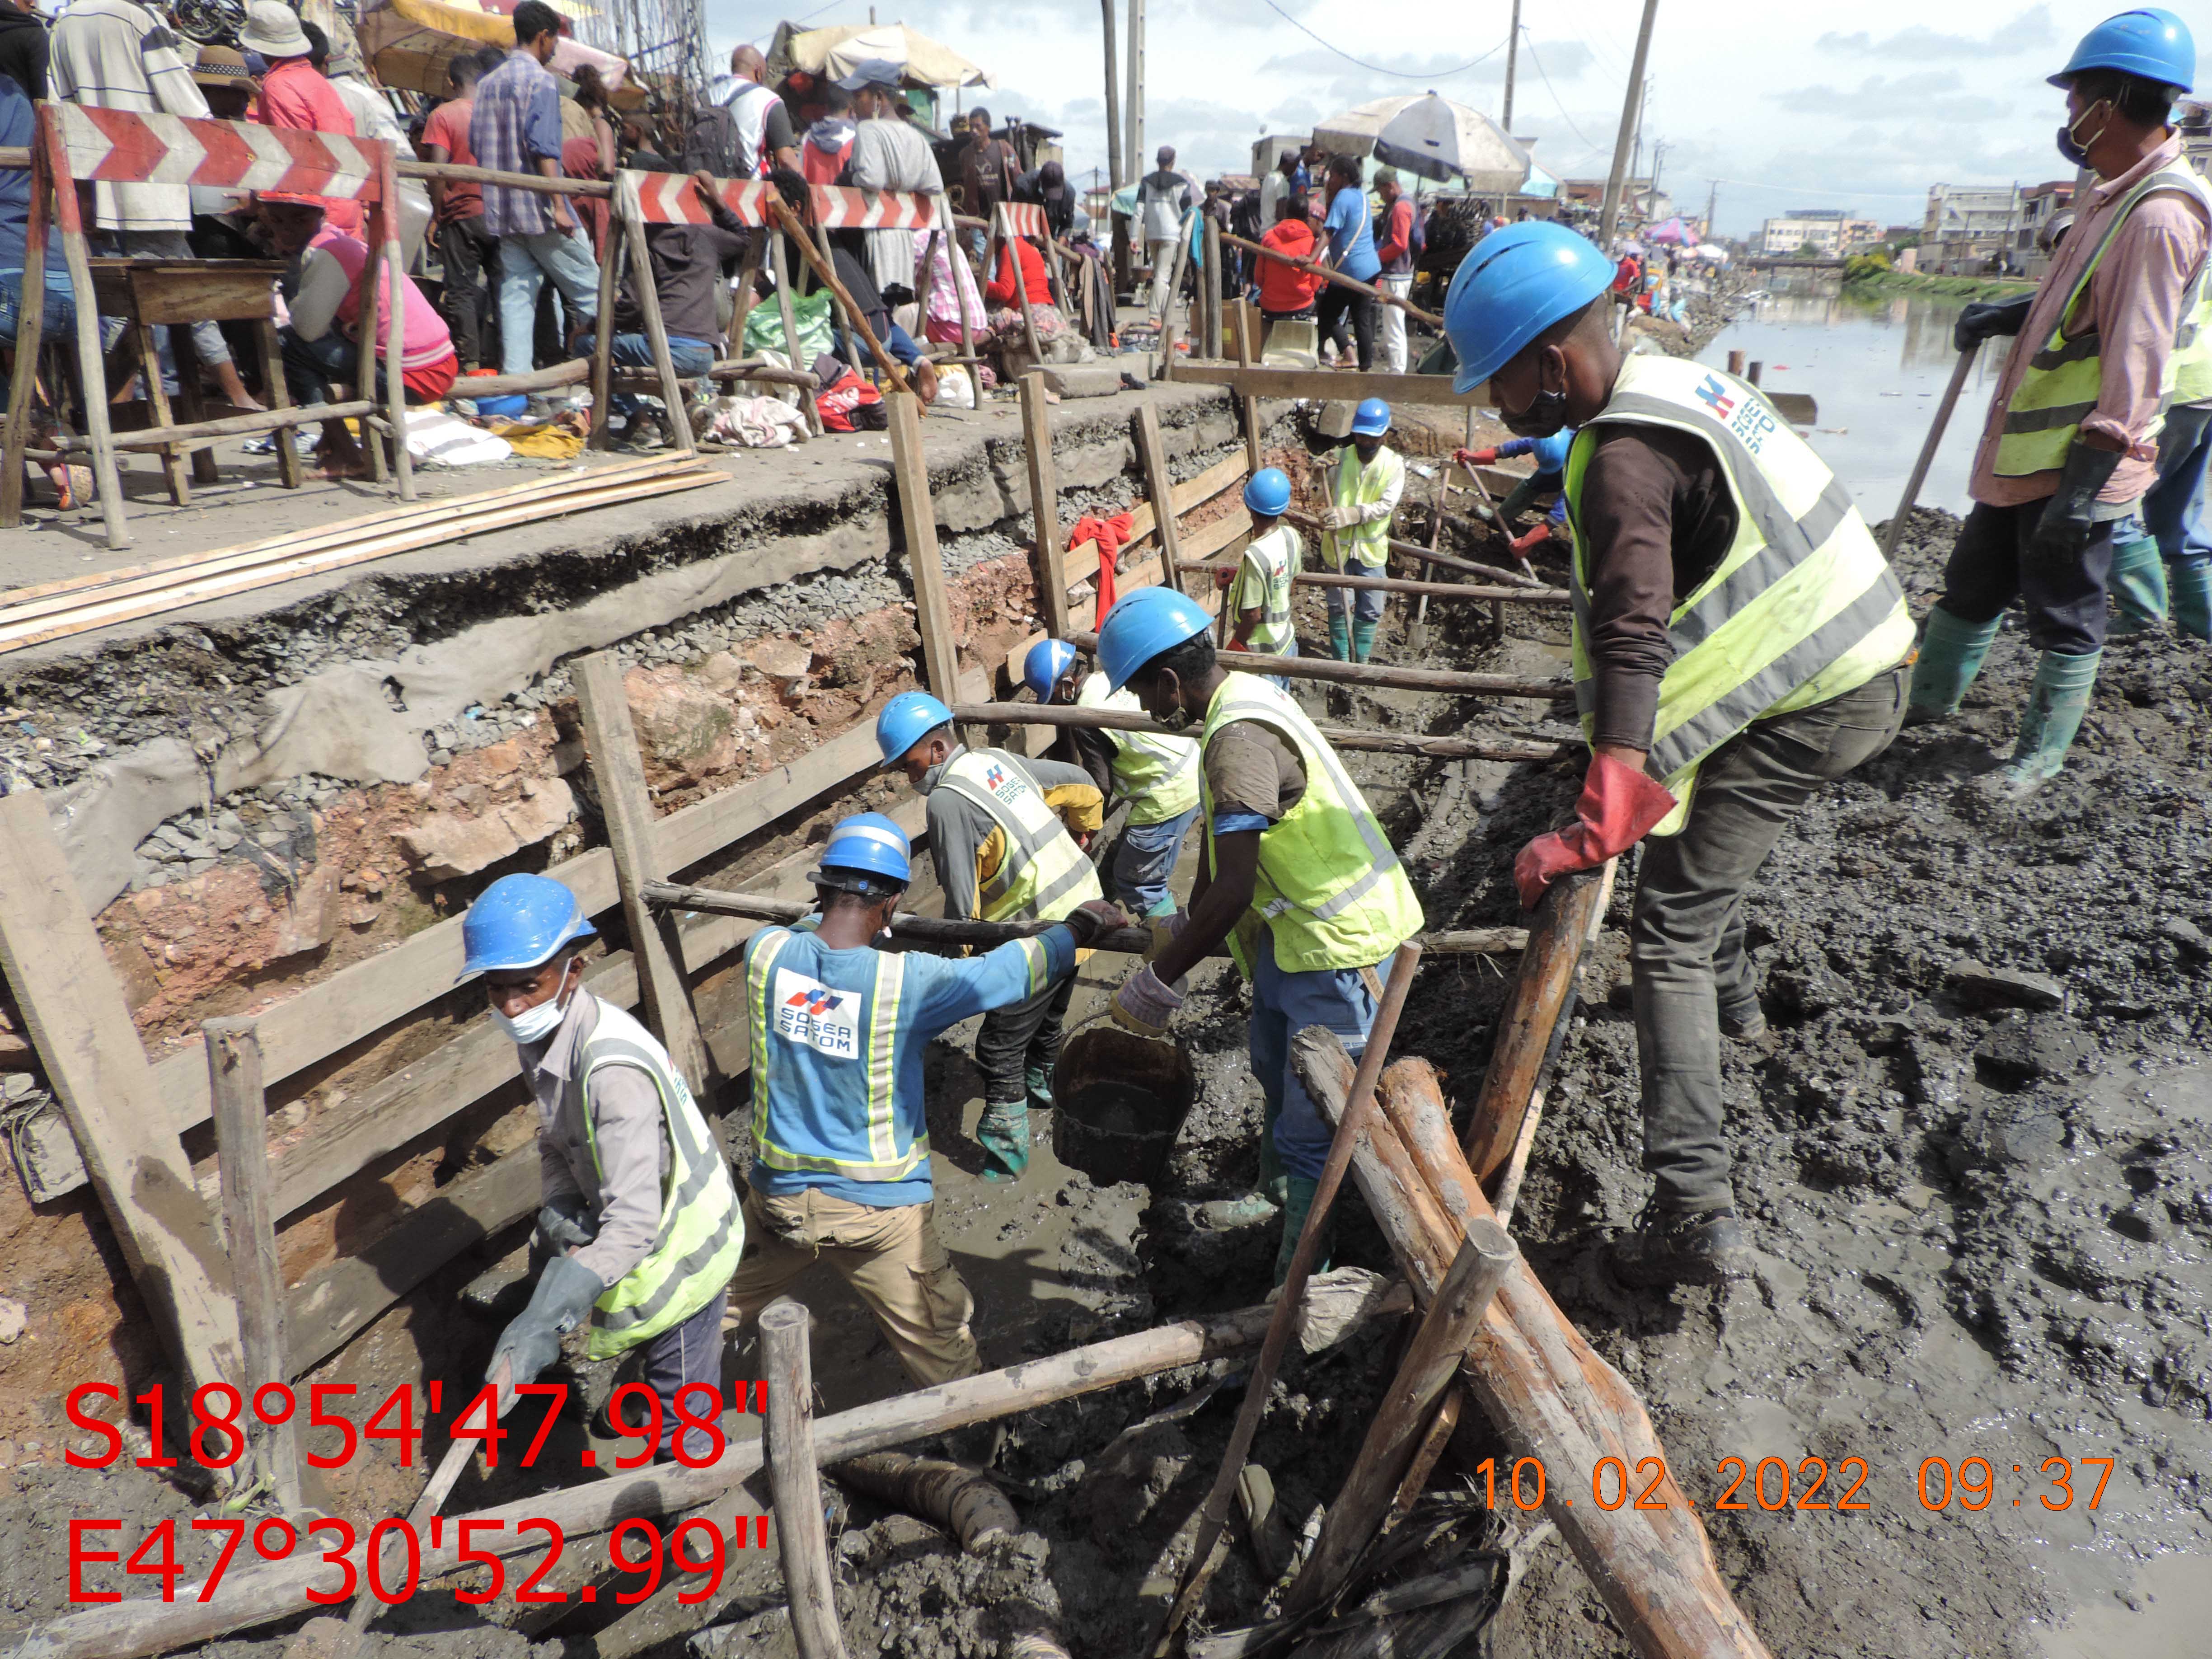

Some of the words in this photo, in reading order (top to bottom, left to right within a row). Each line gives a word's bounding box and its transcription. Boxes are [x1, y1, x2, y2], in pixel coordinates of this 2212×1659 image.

[995, 777, 1020, 798] SOGE
[1003, 784, 1027, 805] SATO
[779, 1020, 851, 1052] SATOM
[781, 1007, 851, 1039] SOGEA
